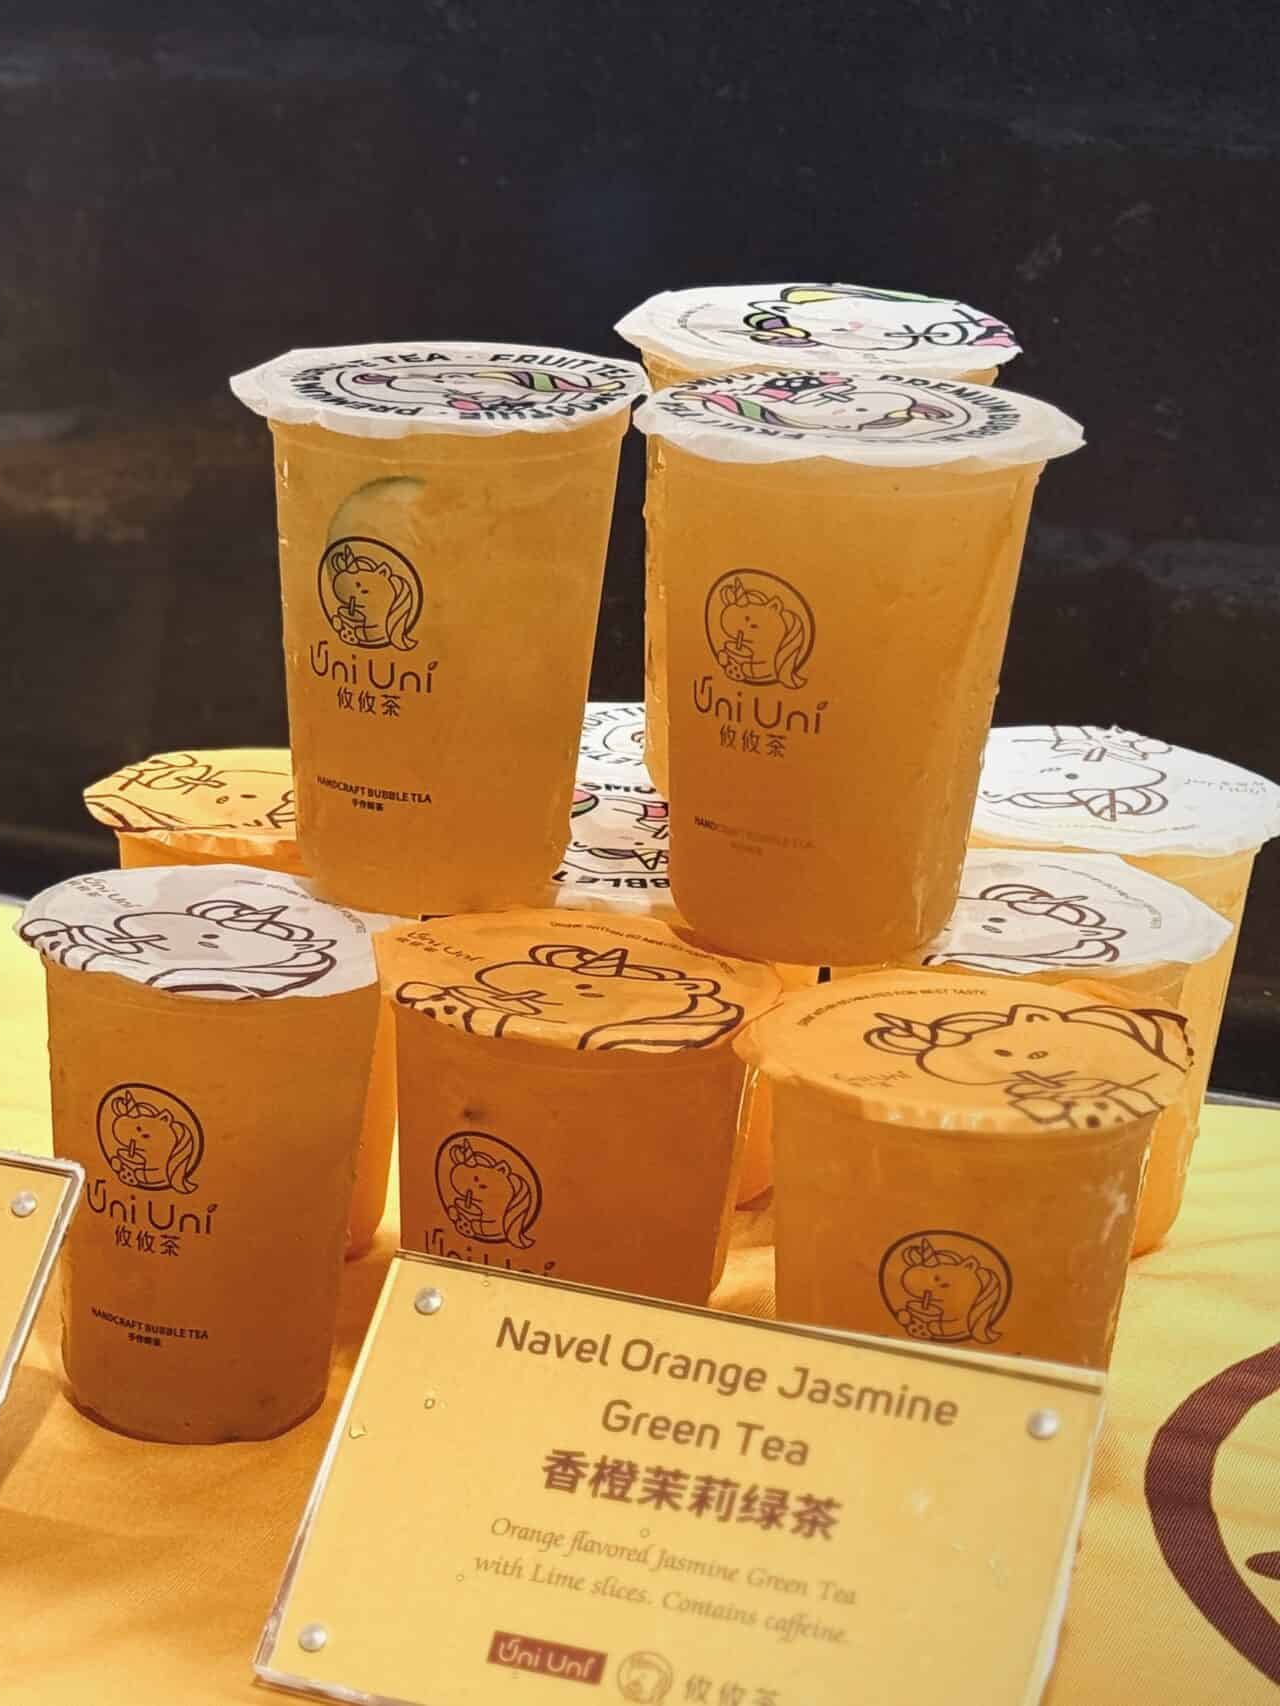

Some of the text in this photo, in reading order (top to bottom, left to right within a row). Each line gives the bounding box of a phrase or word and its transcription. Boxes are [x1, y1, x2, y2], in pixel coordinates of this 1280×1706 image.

[373, 353, 451, 364] TEA
[488, 354, 597, 370] FRUIT
[876, 374, 1018, 413] PREMIUM
[309, 640, 439, 694] Uni Uni
[336, 686, 401, 718] 攸攸茶
[693, 676, 743, 724] Uni
[754, 697, 829, 734] Uni
[719, 724, 787, 759] 攸攸茶
[317, 776, 433, 804] HANDCRAFT BUBBLE TEA
[86, 1179, 219, 1235] Uni Uni
[115, 1224, 182, 1257] 攸攸茶
[144, 1324, 186, 1339] BUBBLE
[187, 1328, 209, 1340] TEA
[495, 1316, 959, 1428] Navel Orange Jasmine
[601, 1398, 810, 1467] Green Tea
[542, 1447, 843, 1542] 香橙茉莉绿茶
[490, 1517, 857, 1606] Orange flavored Jasmine Green Tea
[475, 1553, 850, 1647] with Lime slices. Contains caffeine.
[498, 1638, 595, 1680] Uni Uni
